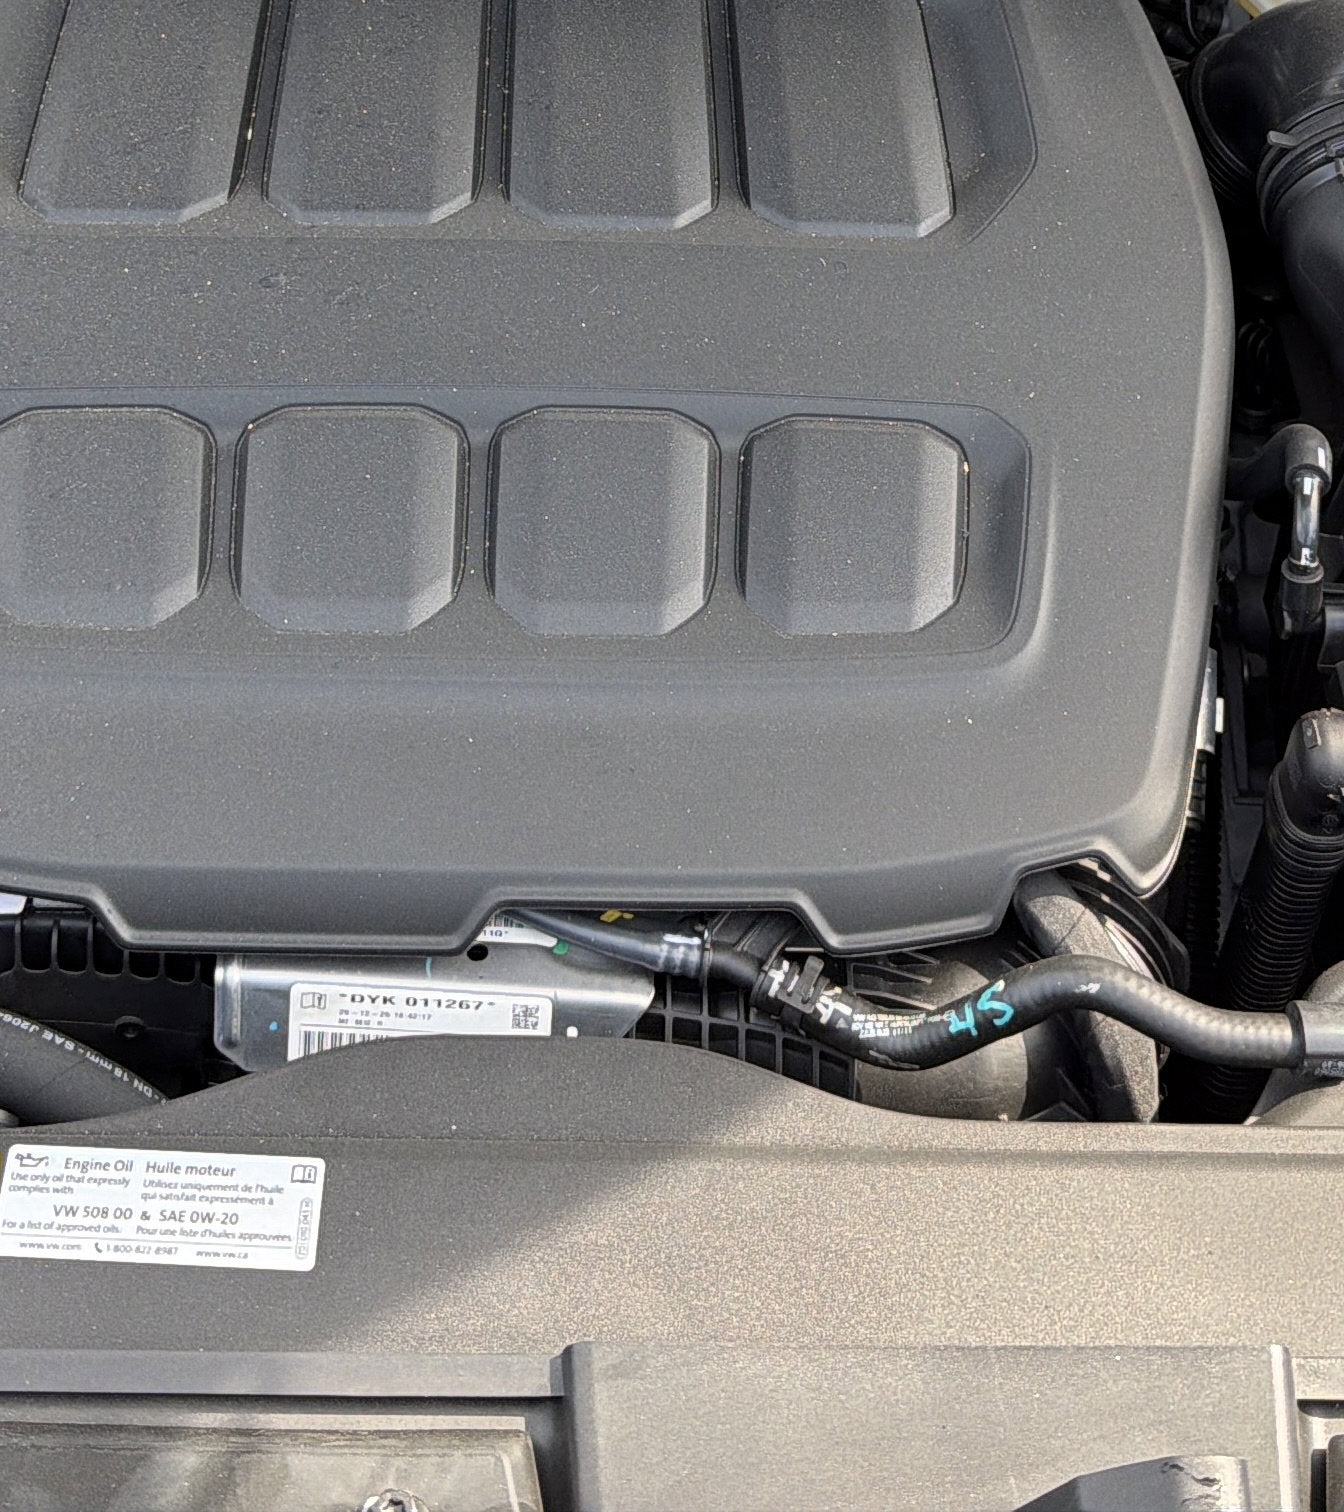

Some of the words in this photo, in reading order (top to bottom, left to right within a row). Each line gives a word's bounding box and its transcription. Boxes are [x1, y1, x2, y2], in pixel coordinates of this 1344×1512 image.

[42, 1029, 76, 1051] SAE
[64, 1157, 111, 1174] Engine
[113, 1159, 133, 1172] Oil
[145, 1160, 181, 1175] Huile
[184, 1164, 236, 1177] moteur
[10, 1172, 28, 1181] Use
[30, 1174, 50, 1183] only
[52, 1174, 64, 1182] oil
[66, 1175, 84, 1184] that
[87, 1177, 131, 1188] expressly
[180, 1182, 239, 1193] uniquement
[241, 1184, 253, 1193] de
[8, 1184, 50, 1195] complies
[52, 1186, 74, 1195] with
[141, 1192, 157, 1202] qui
[159, 1193, 196, 1203] satisfait
[53, 1204, 79, 1218] VW
[83, 1205, 109, 1219] 508
[113, 1207, 133, 1220] 00
[140, 1210, 151, 1221] &
[159, 1209, 186, 1222] SAE
[190, 1211, 240, 1225] 0W-20
[2, 1219, 17, 1229] For
[27, 1220, 41, 1230] list
[43, 1221, 54, 1230] of
[56, 1222, 100, 1234] approved
[136, 1225, 157, 1236] Pour
[159, 1228, 177, 1237] une
[179, 1227, 199, 1238] liste
